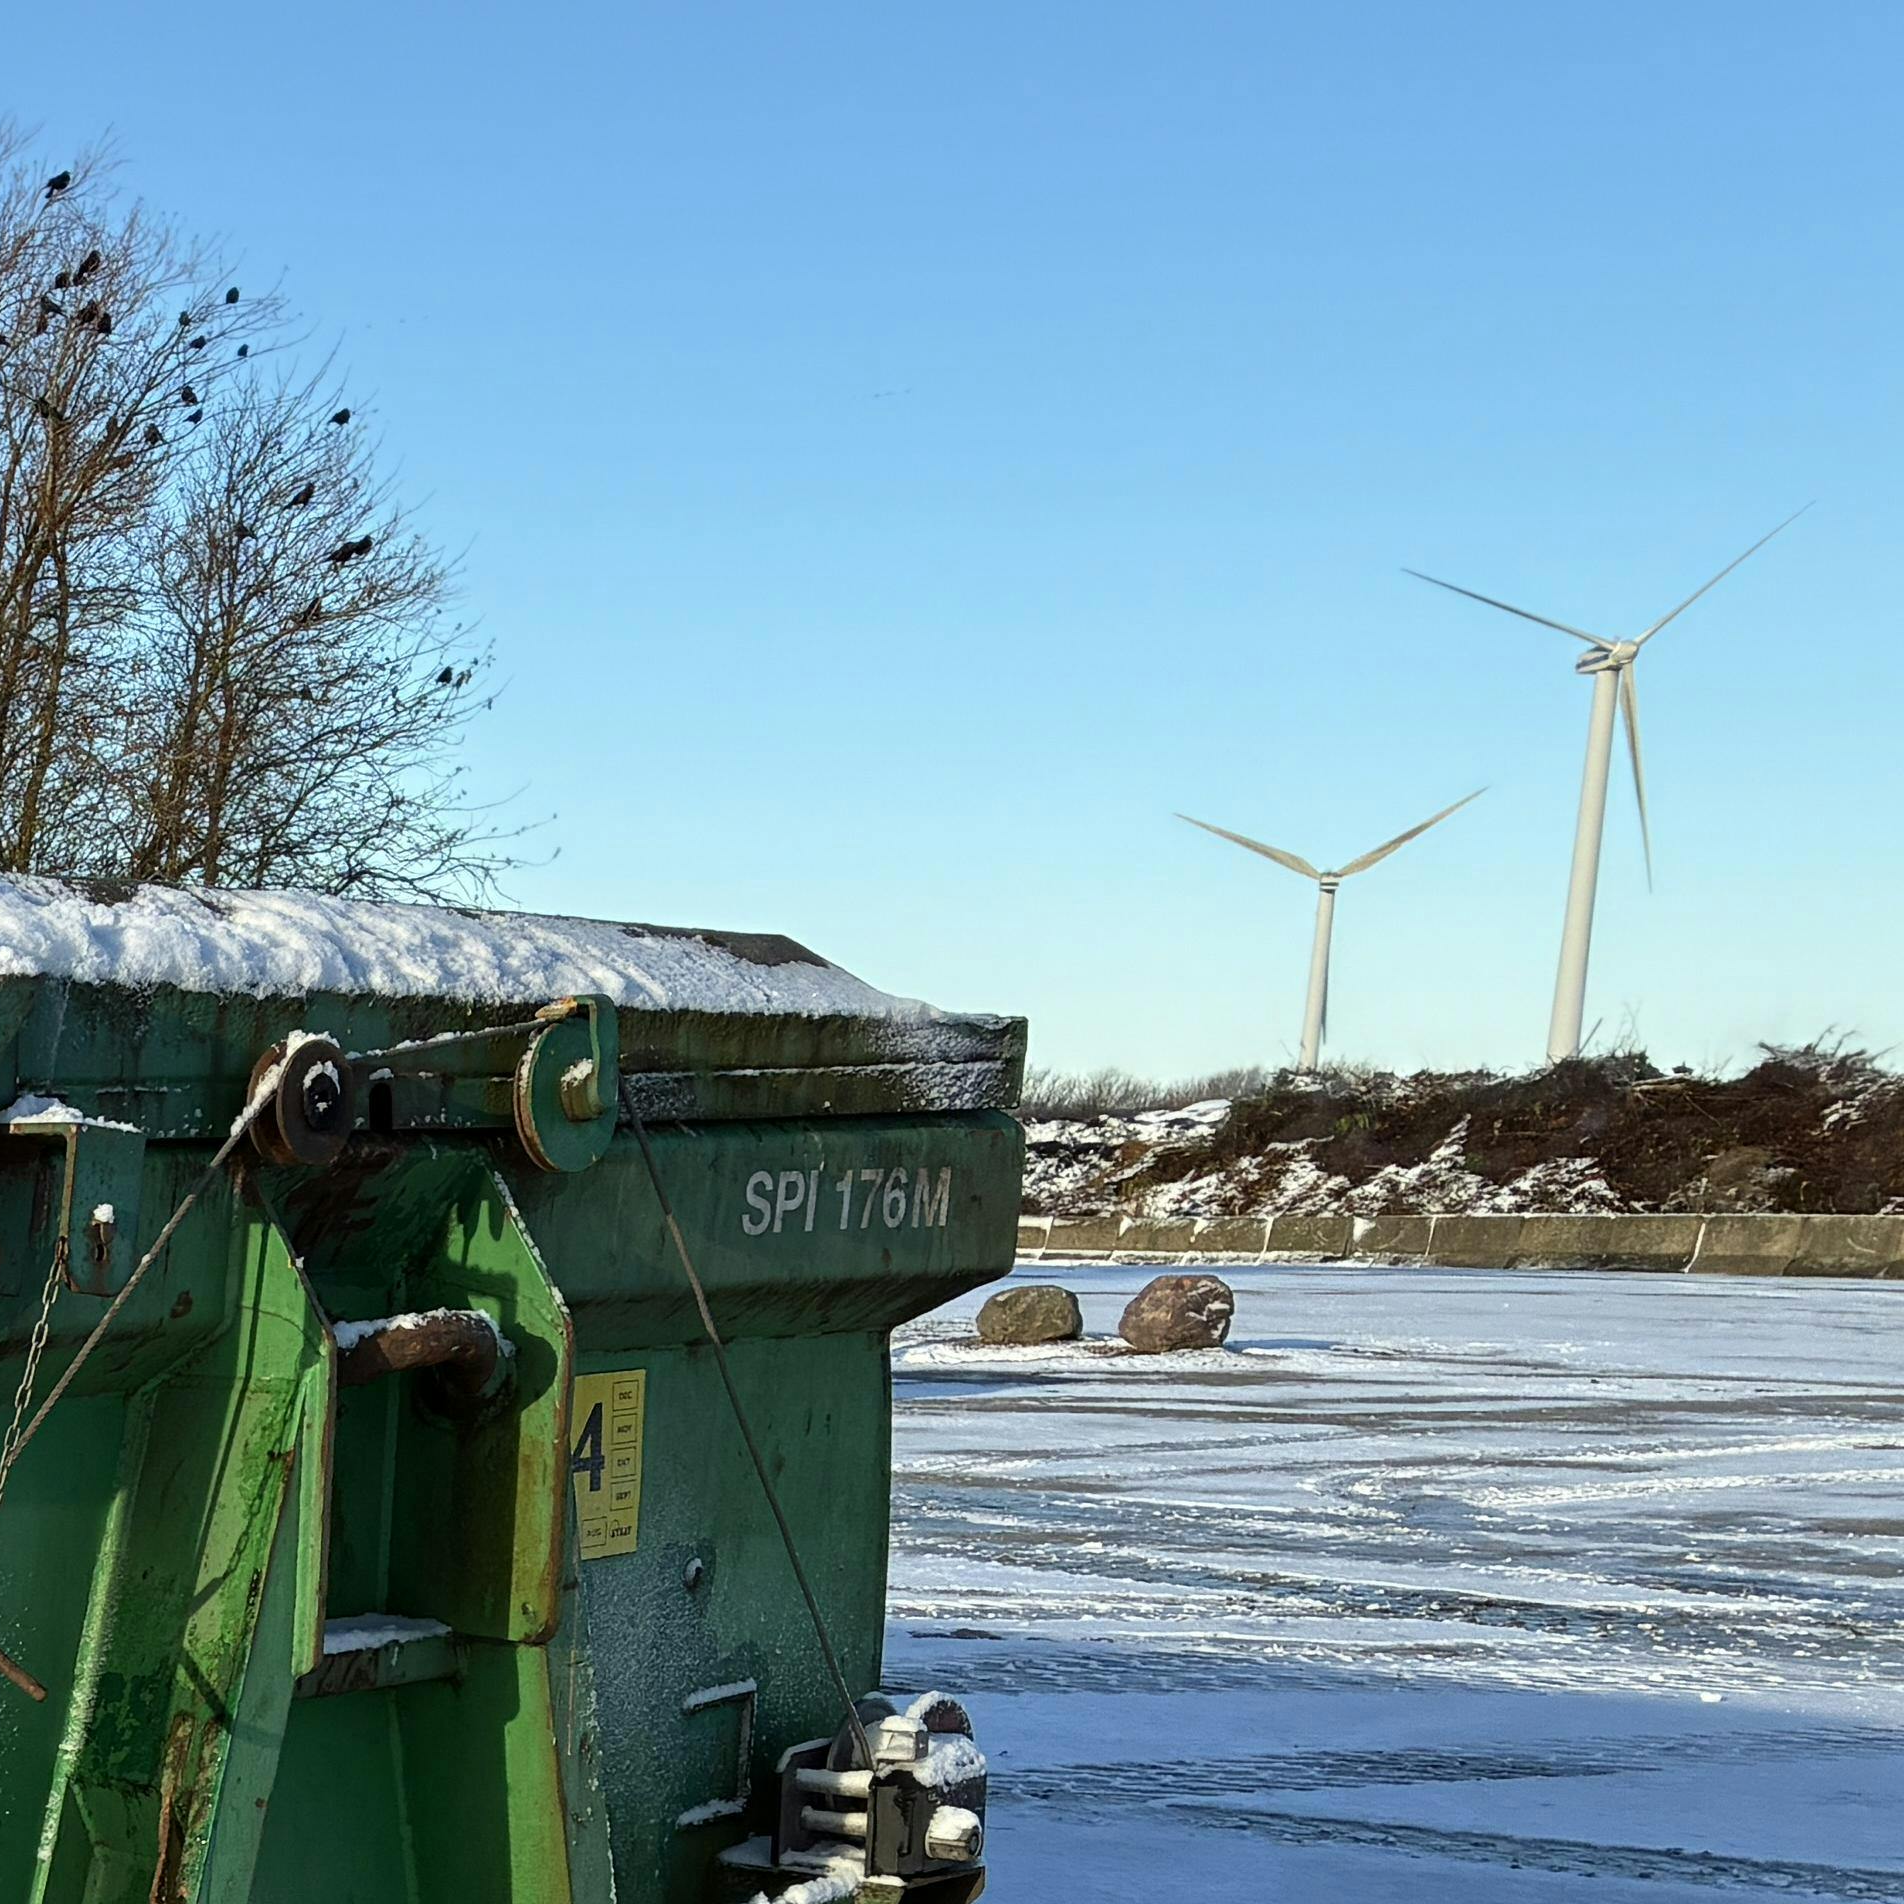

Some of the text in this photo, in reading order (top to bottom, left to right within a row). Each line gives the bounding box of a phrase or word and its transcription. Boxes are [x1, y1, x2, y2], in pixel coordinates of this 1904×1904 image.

[742, 1165, 952, 1236] SPI 176M
[572, 1401, 606, 1492] 4
